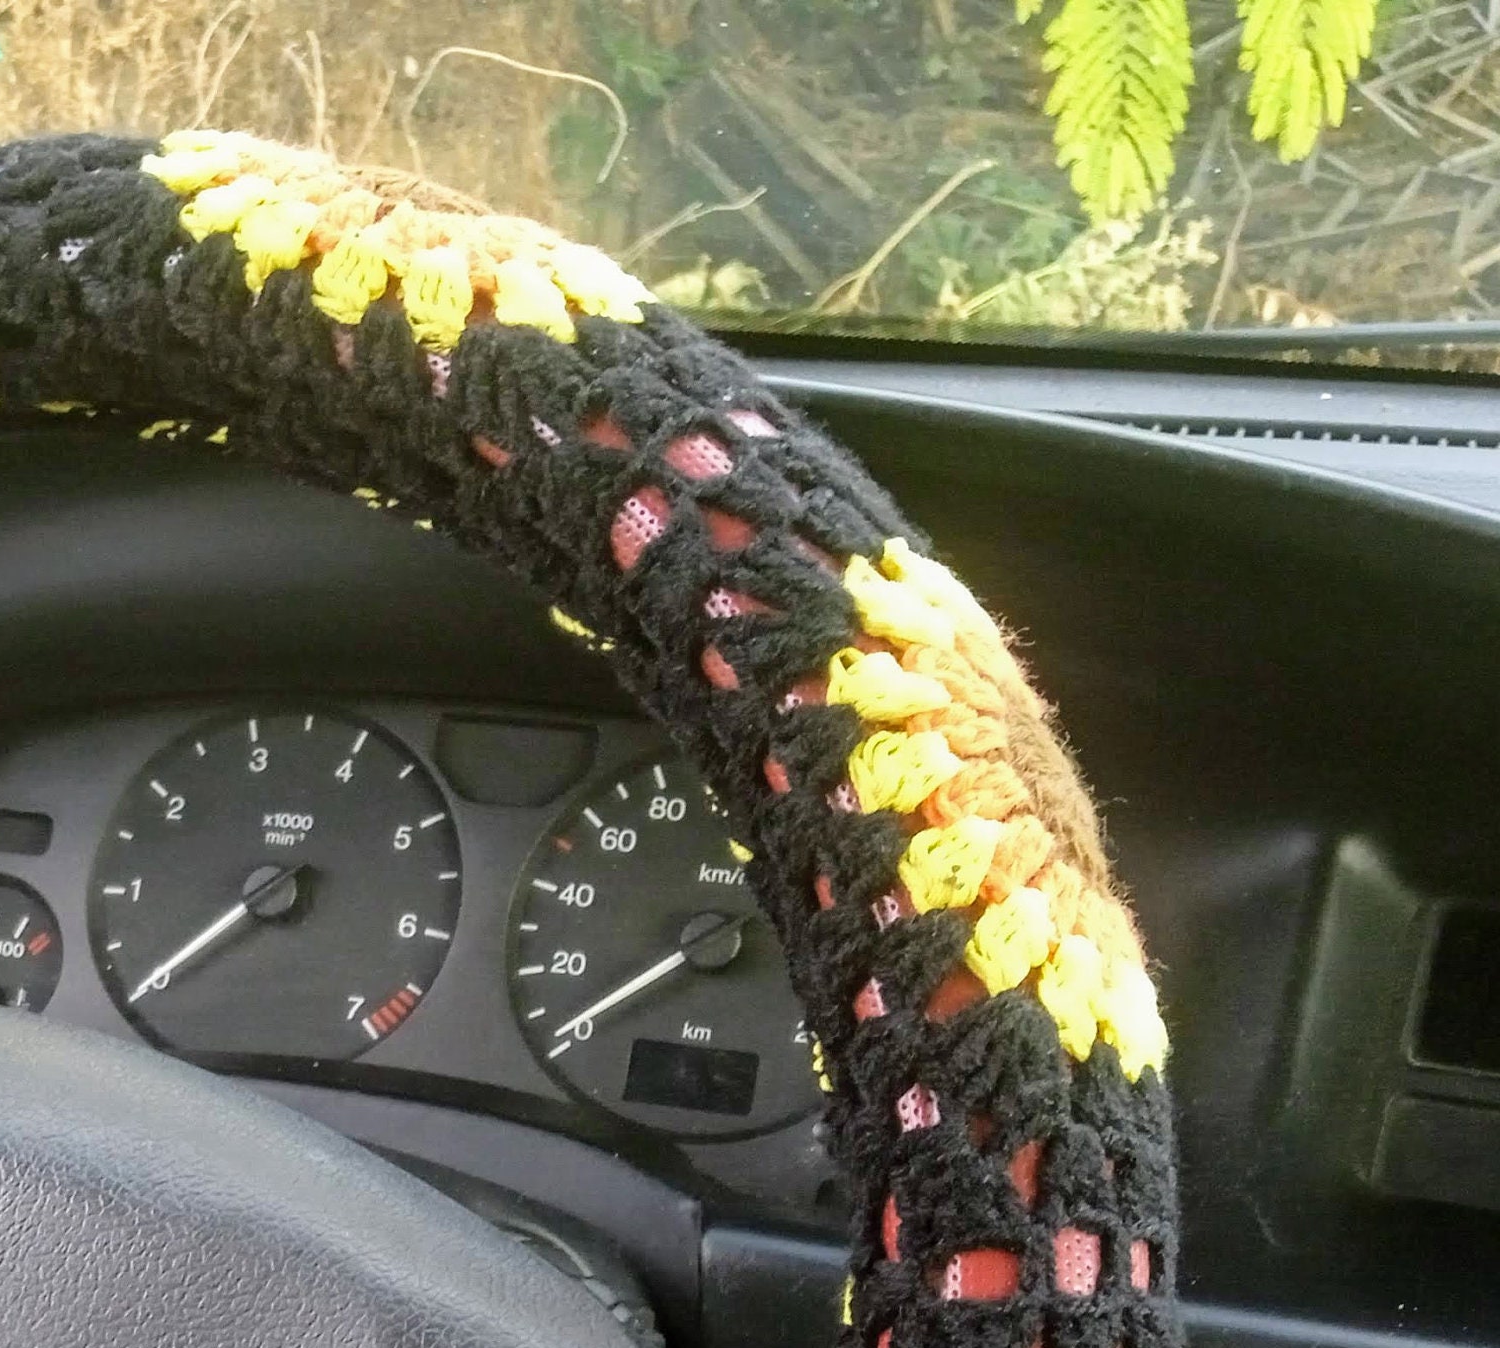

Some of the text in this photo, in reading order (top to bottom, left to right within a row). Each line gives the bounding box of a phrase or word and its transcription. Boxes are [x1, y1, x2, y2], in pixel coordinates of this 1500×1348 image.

[248, 748, 268, 773] 3
[334, 759, 353, 783] 4
[165, 796, 186, 820] 2
[648, 796, 687, 822] 80
[393, 825, 413, 850] 5
[599, 827, 637, 853] 60
[131, 878, 142, 902] 1
[557, 883, 596, 908] 40
[398, 913, 418, 938] 6
[550, 950, 587, 976] 20
[347, 996, 367, 1021] 7
[573, 1018, 594, 1041] 0
[682, 1021, 712, 1042] km
